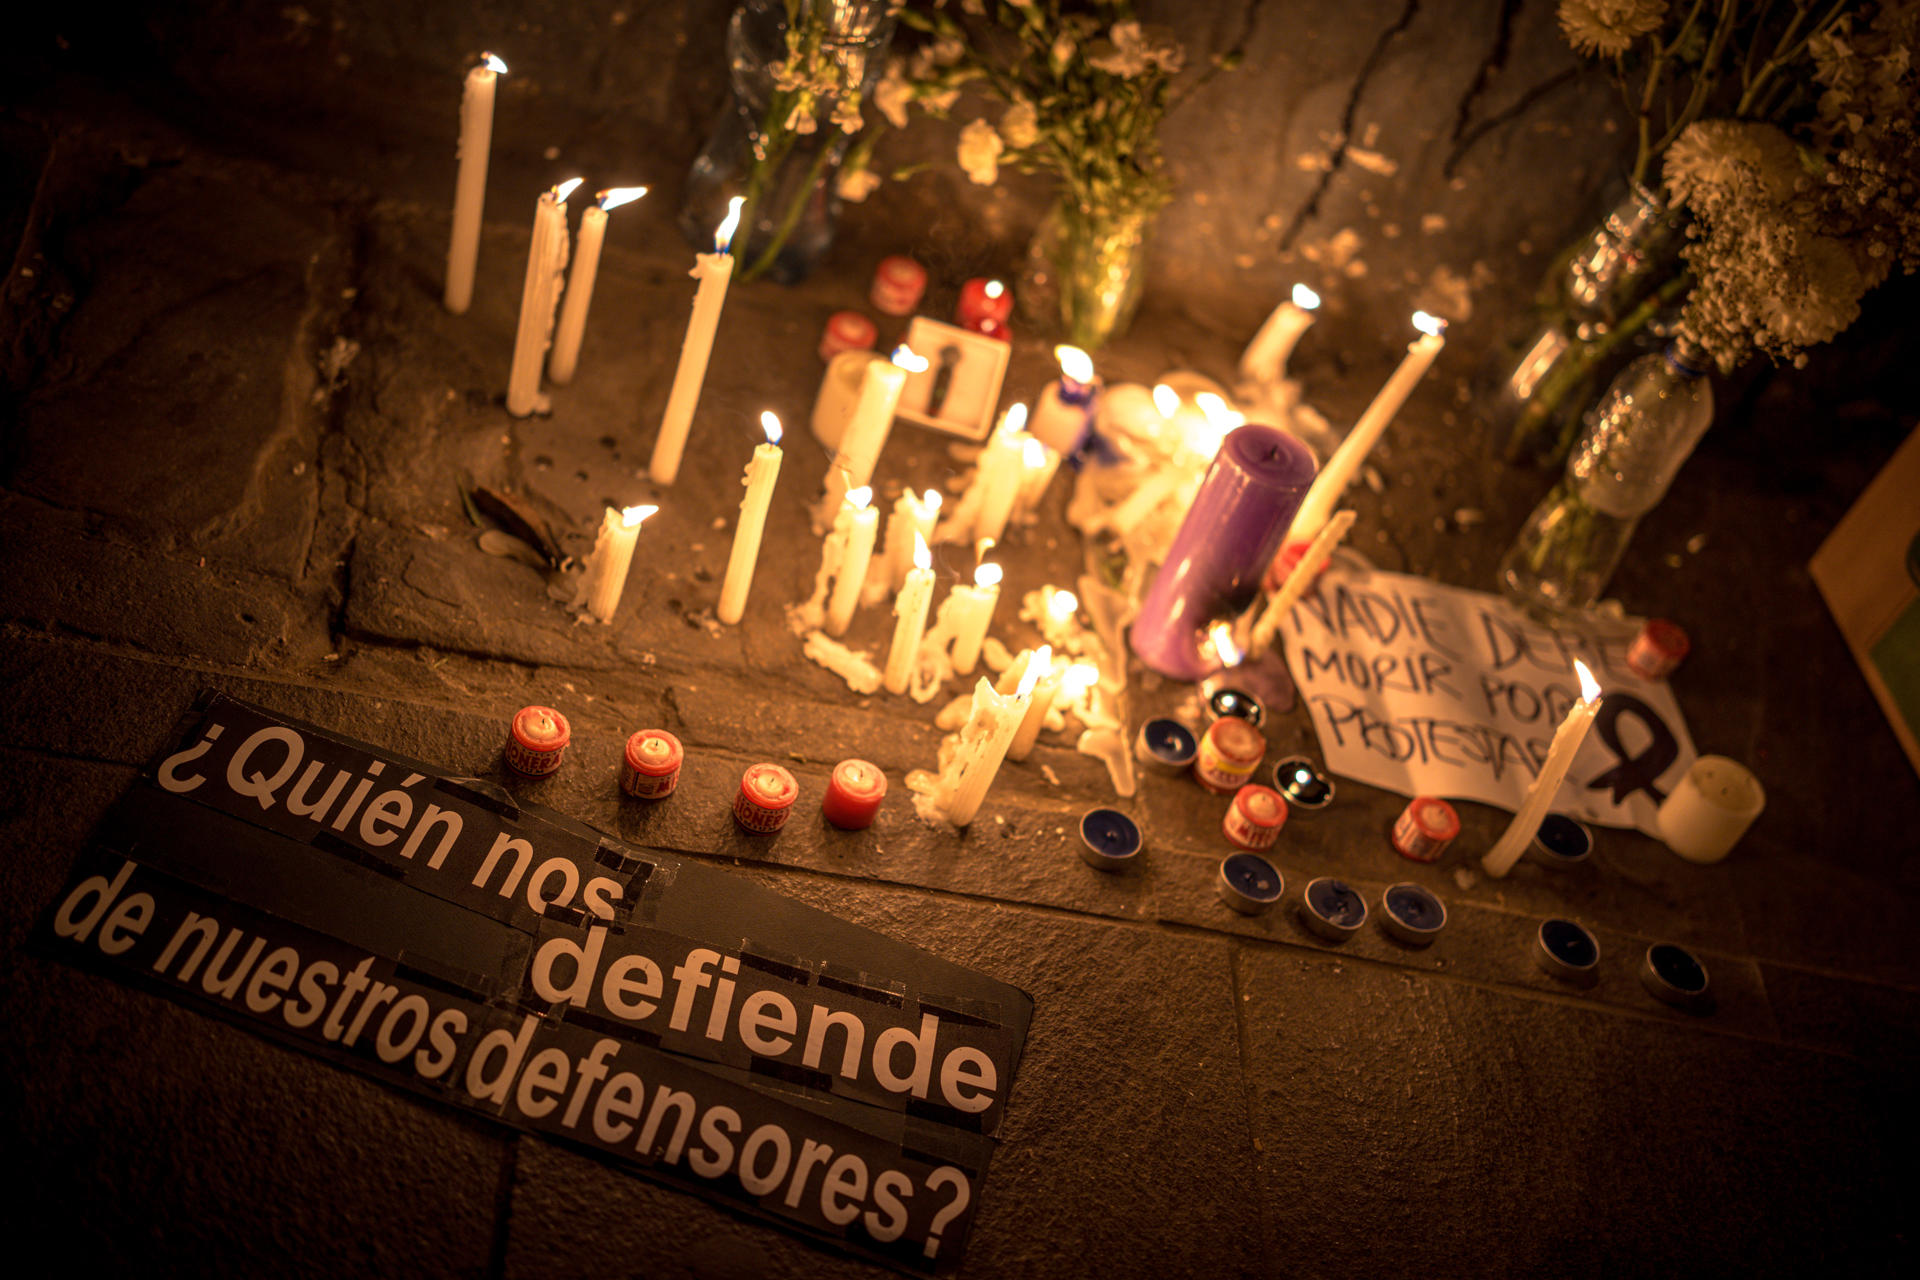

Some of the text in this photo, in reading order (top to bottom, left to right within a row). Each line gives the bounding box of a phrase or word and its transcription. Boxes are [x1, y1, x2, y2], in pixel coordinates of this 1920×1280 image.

[1290, 582, 1465, 664] NADIE
[1302, 647, 1463, 702] MORIR
[157, 723, 625, 921] ¿Quién nos
[53, 861, 971, 1259] de nuestros defensores?
[530, 925, 998, 1113] defiende
